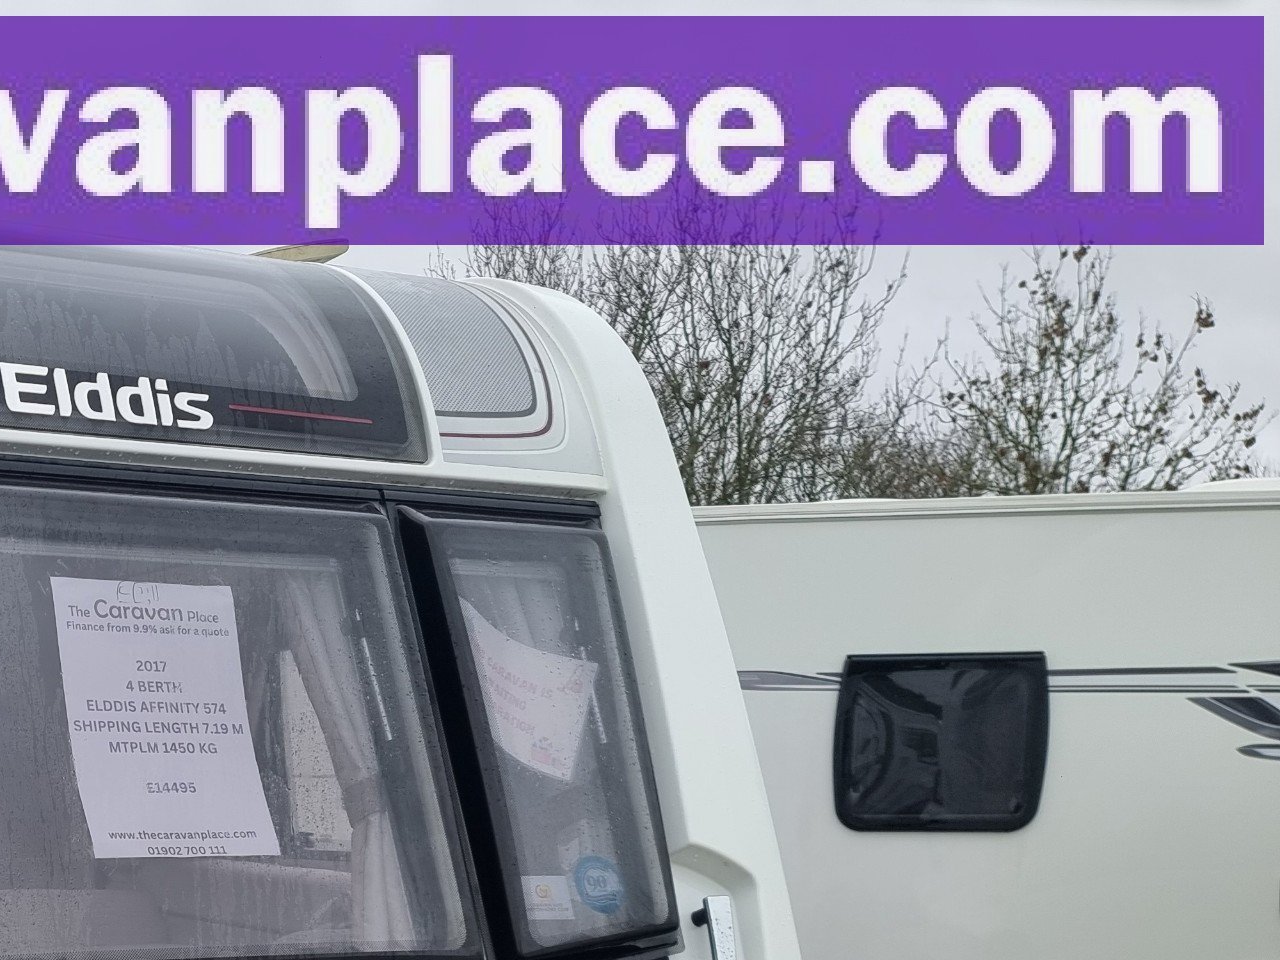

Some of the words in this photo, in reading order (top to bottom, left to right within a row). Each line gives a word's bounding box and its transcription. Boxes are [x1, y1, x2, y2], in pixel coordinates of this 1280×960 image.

[68, 605, 90, 618] The
[94, 599, 183, 621] Caravan
[188, 611, 219, 623] Place
[66, 621, 104, 633] Finance
[107, 623, 131, 633] from
[133, 624, 157, 633] 9.9%
[159, 625, 175, 635] ask
[177, 626, 191, 635] for
[201, 627, 229, 638] quote
[136, 661, 167, 672] 2017
[126, 680, 134, 692] 4
[138, 681, 183, 693] BERTH
[87, 700, 136, 713] ELDDIS
[140, 702, 199, 714] AFFINITY
[203, 703, 226, 714] 574
[74, 720, 141, 733] SHIPPING
[145, 722, 199, 734] LENGTH
[202, 723, 228, 734] 7.19
[232, 724, 243, 735] M
[109, 742, 159, 753] MTPLM
[163, 743, 195, 754] 1450
[199, 743, 217, 754] KG
[147, 782, 196, 794] £14495
[108, 830, 256, 842] www.thecaravanplace.com
[148, 846, 182, 855] 01902
[183, 846, 206, 855] 700
[210, 846, 227, 855] 111
